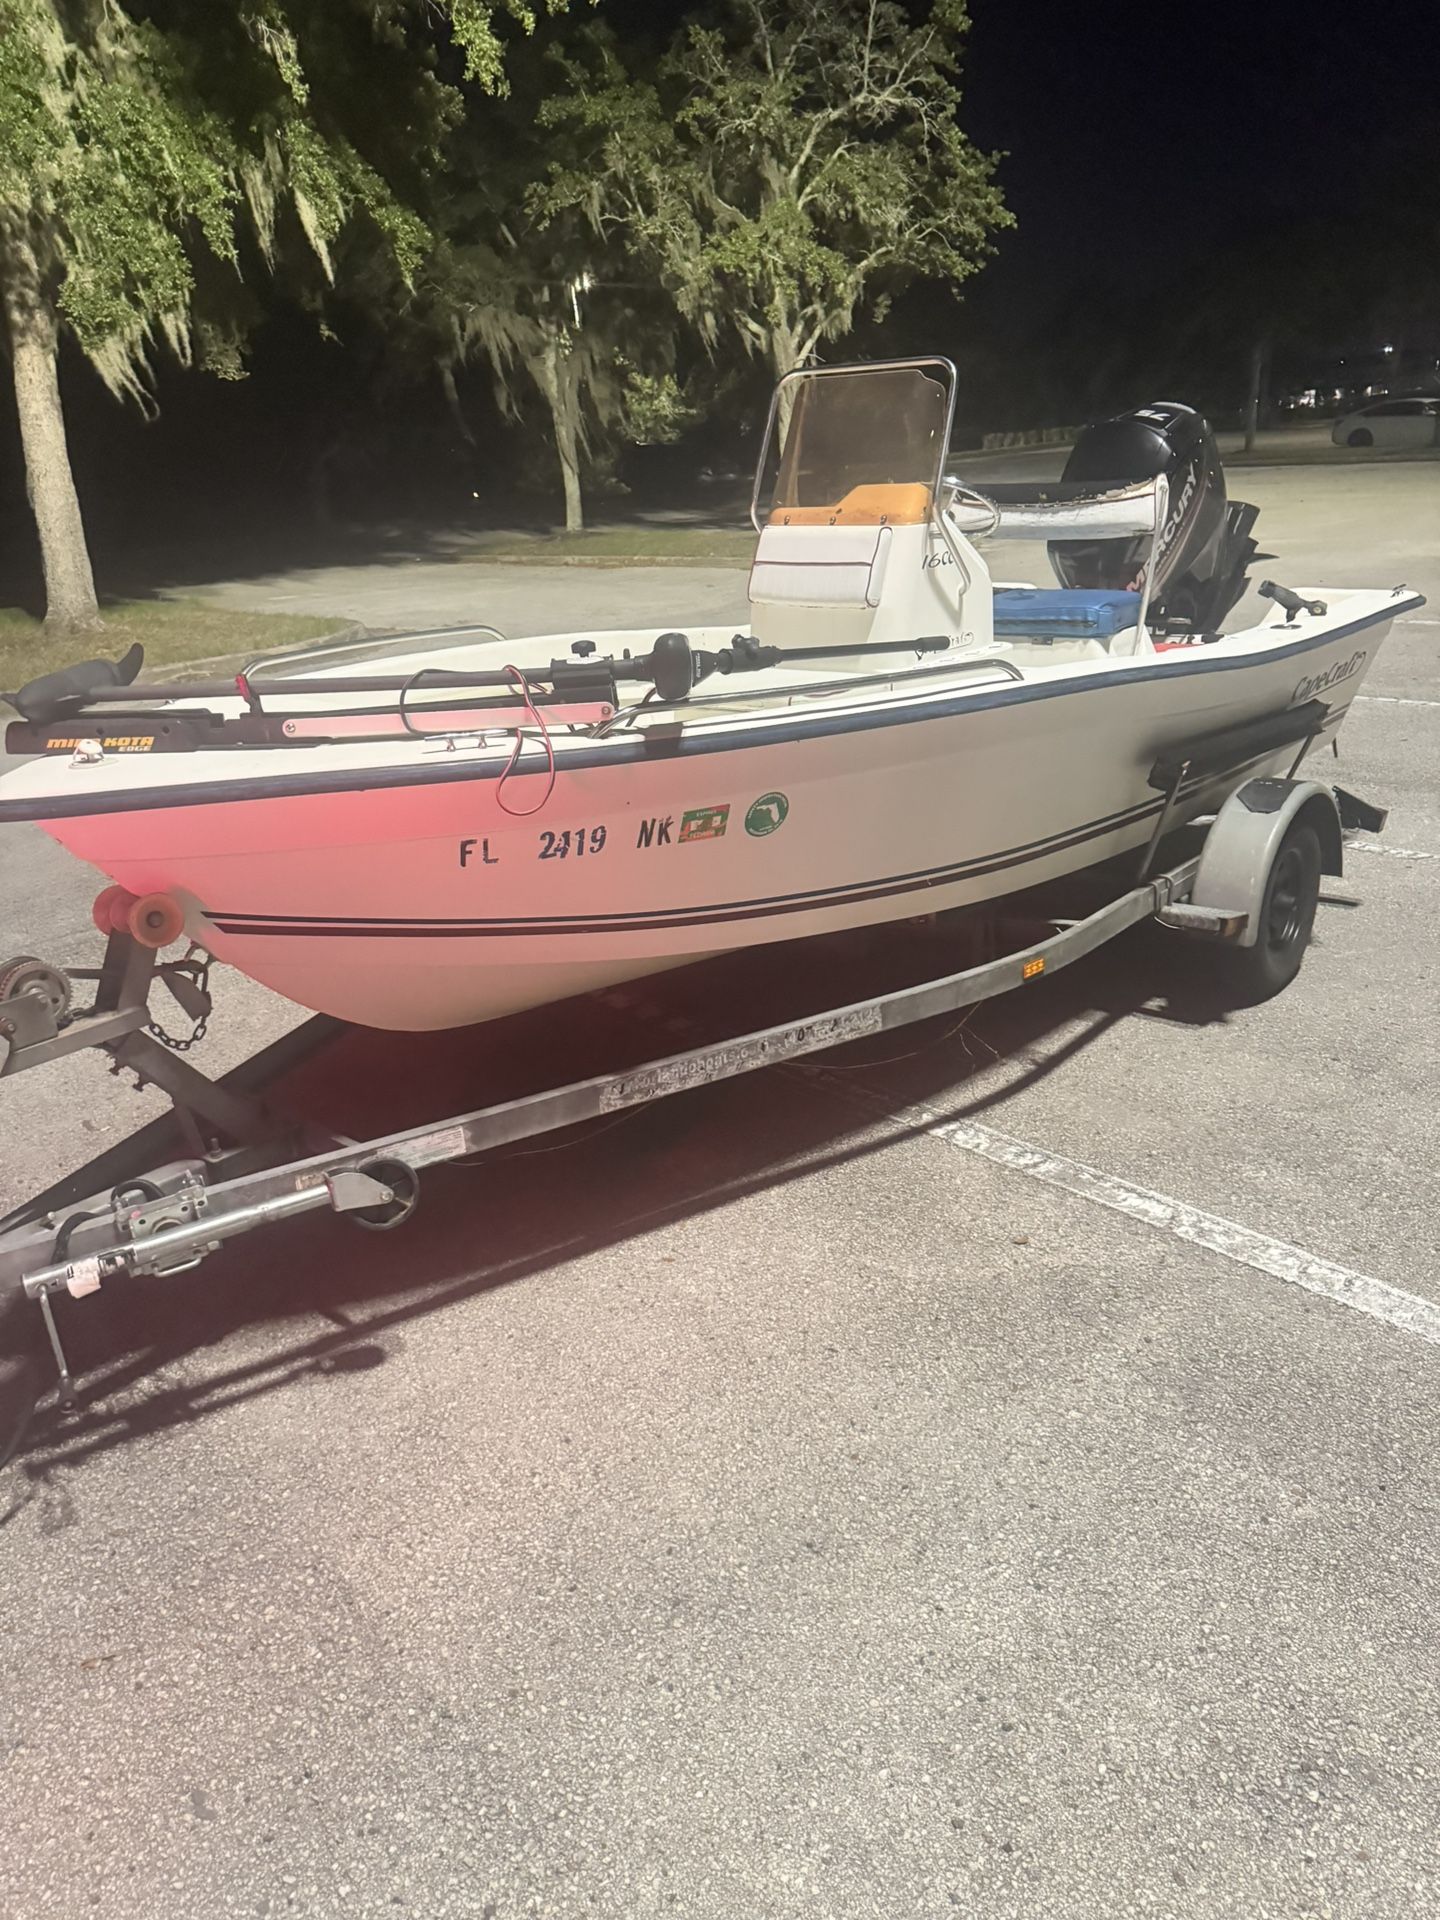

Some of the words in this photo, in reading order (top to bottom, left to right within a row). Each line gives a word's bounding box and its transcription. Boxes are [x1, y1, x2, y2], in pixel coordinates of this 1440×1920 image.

[103, 736, 155, 747] KOTA
[459, 838, 500, 867] FL
[538, 825, 607, 860] 2419
[637, 815, 675, 849] NK
